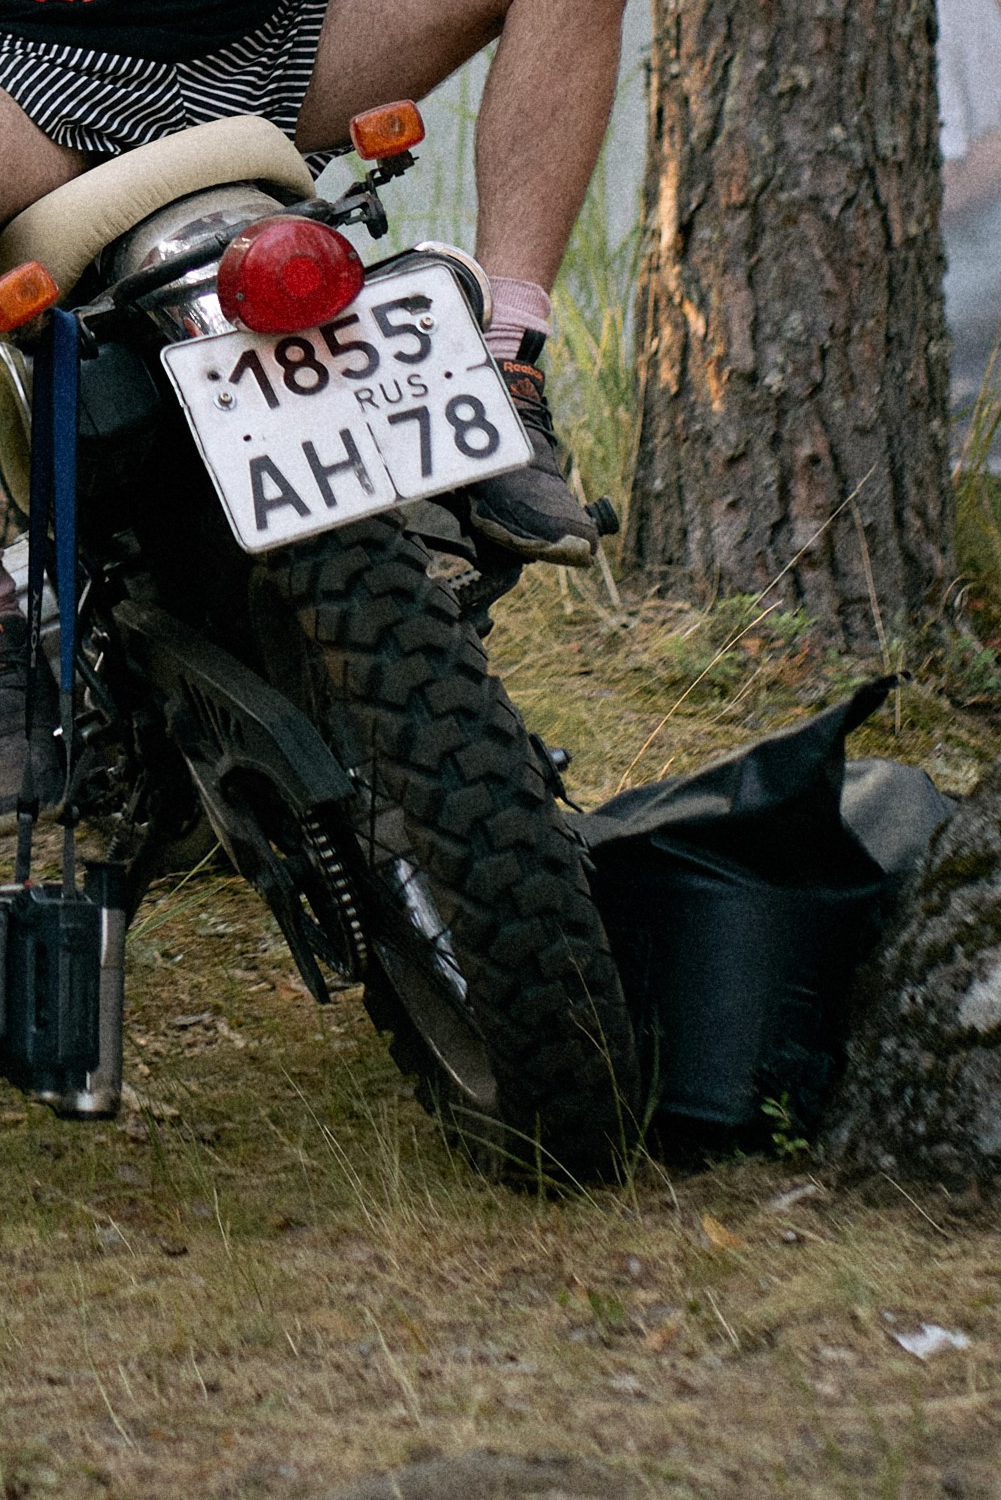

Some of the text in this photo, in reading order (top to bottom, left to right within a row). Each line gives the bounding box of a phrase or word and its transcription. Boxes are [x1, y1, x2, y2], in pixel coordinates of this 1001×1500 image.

[228, 295, 433, 410] 1855
[353, 373, 429, 413] RUS
[249, 393, 501, 531] AH 78
